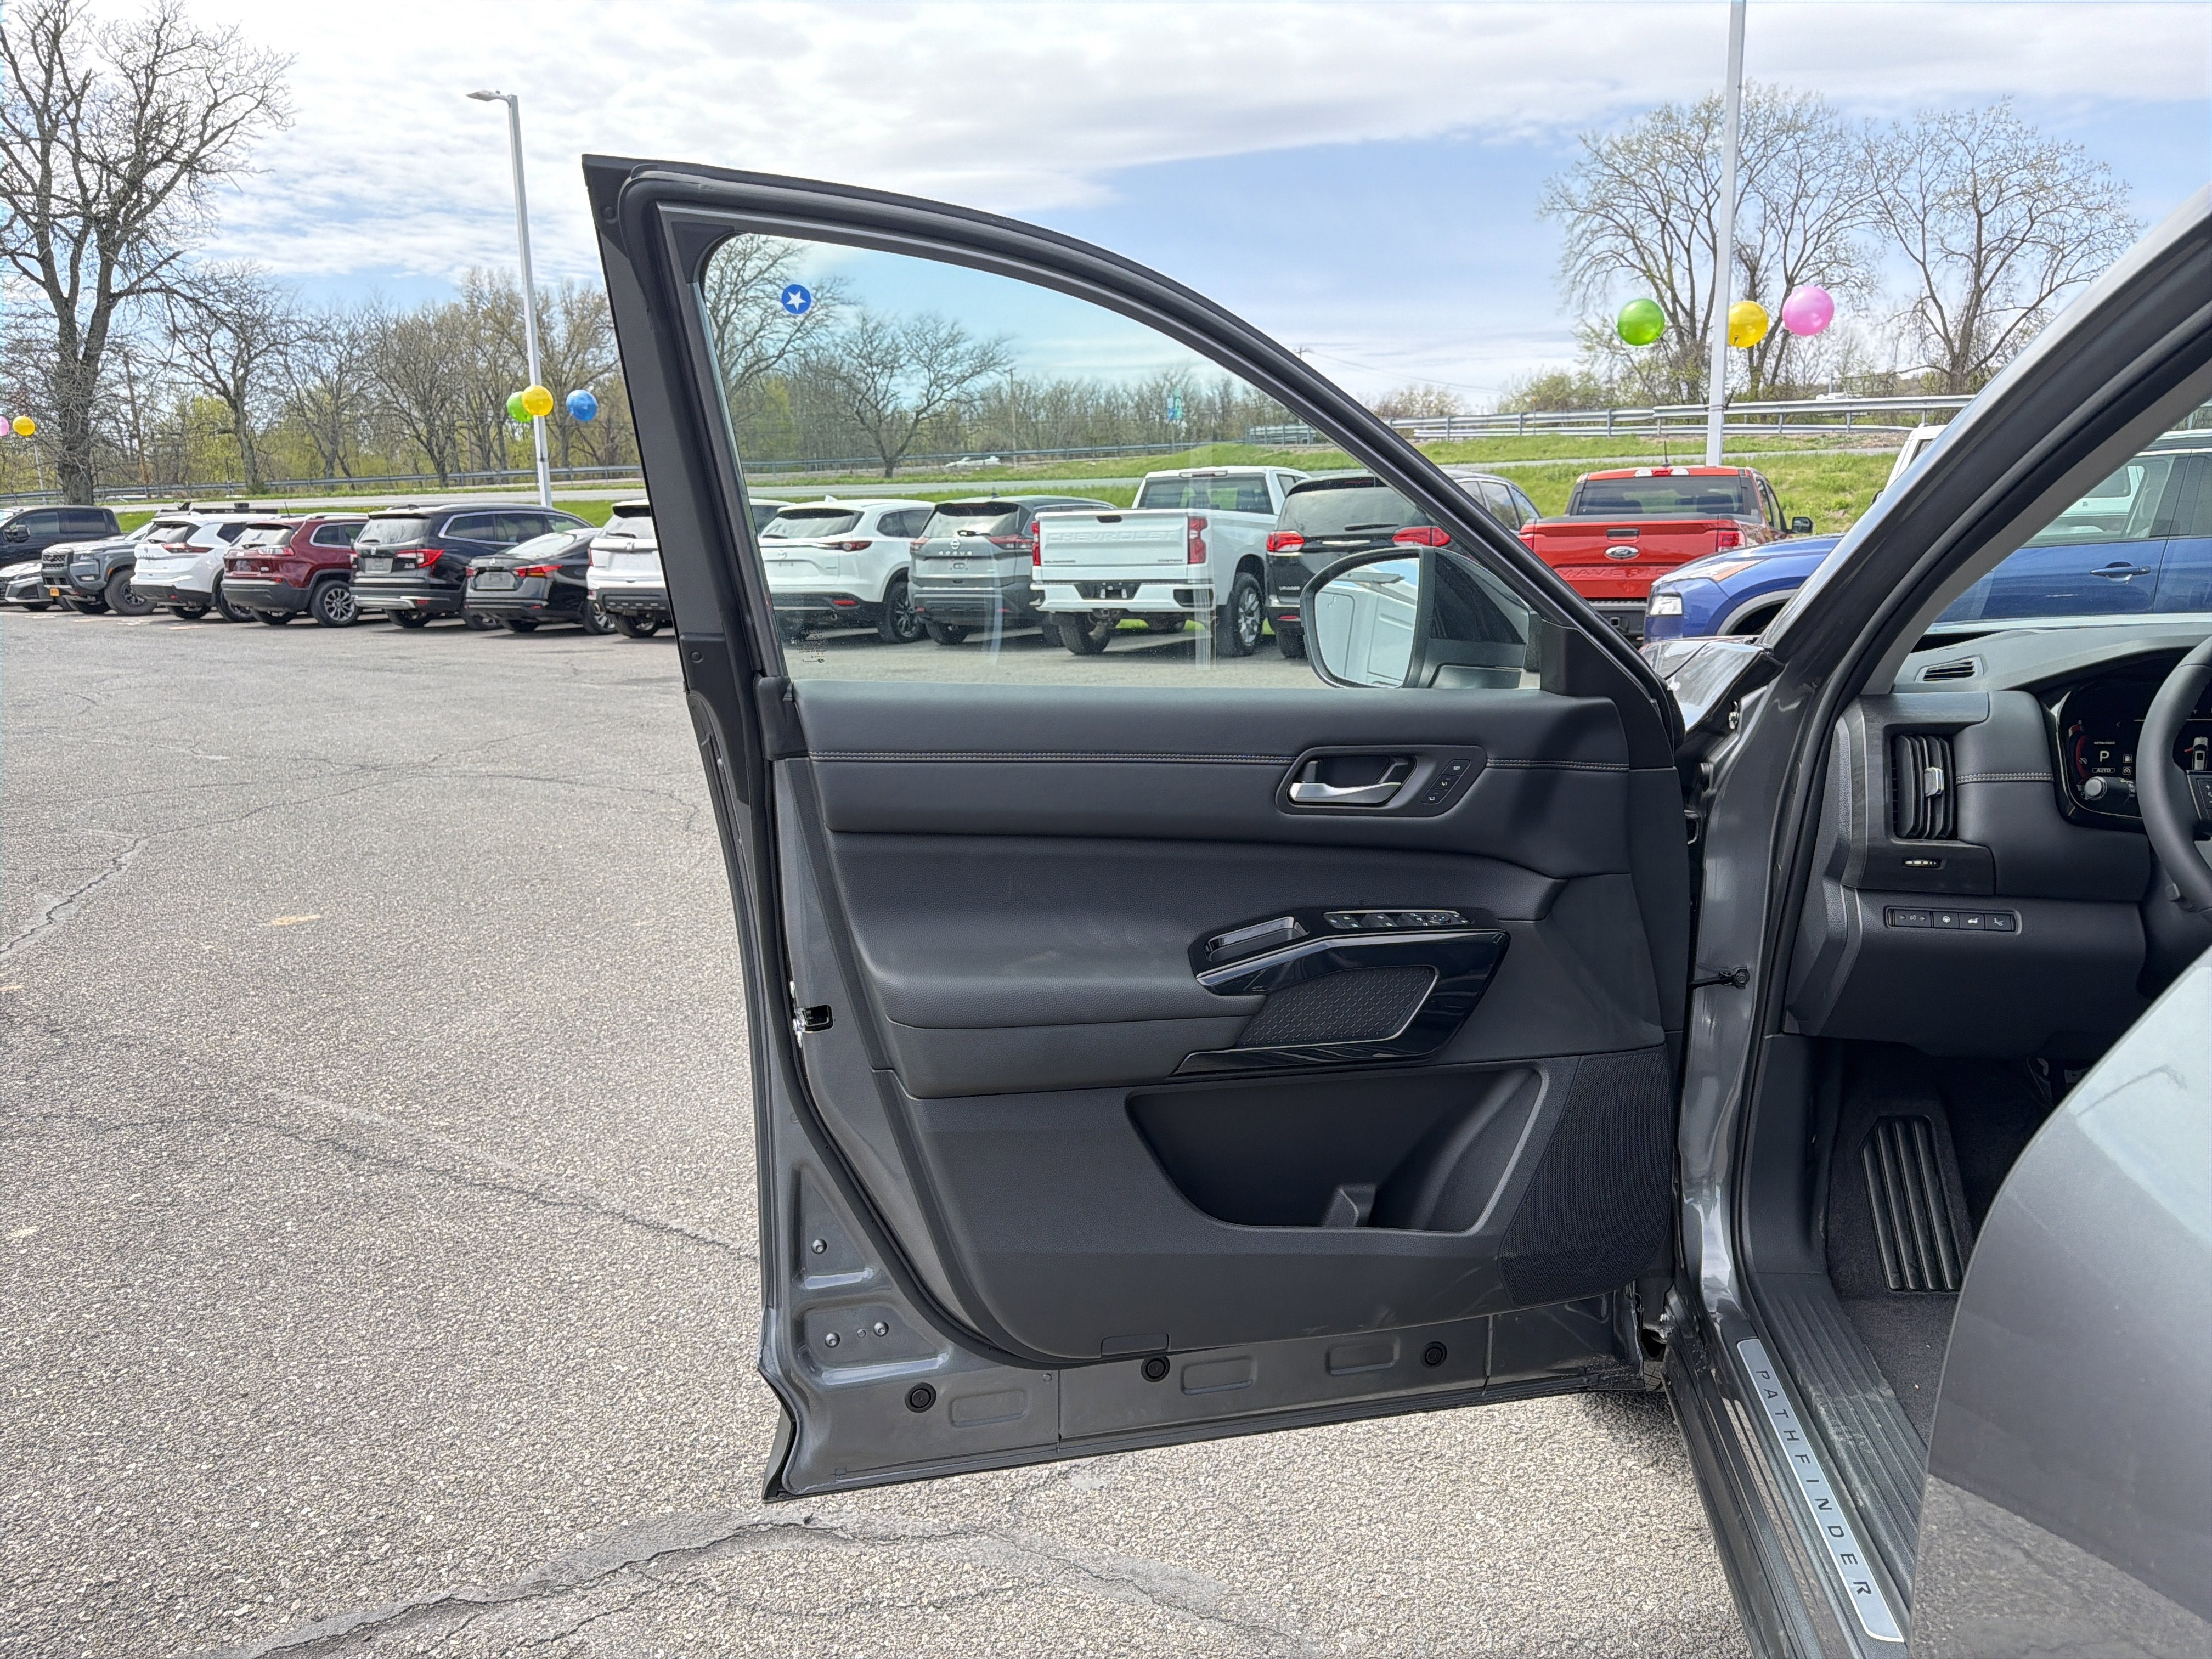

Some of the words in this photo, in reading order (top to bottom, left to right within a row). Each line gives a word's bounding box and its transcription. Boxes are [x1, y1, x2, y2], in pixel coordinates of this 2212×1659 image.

[1048, 531, 1176, 543] CHEVROLET
[1559, 567, 1668, 578] MAVERIC
[2100, 751, 2109, 763] P
[1756, 1370, 1872, 1595] PATHFINDER
